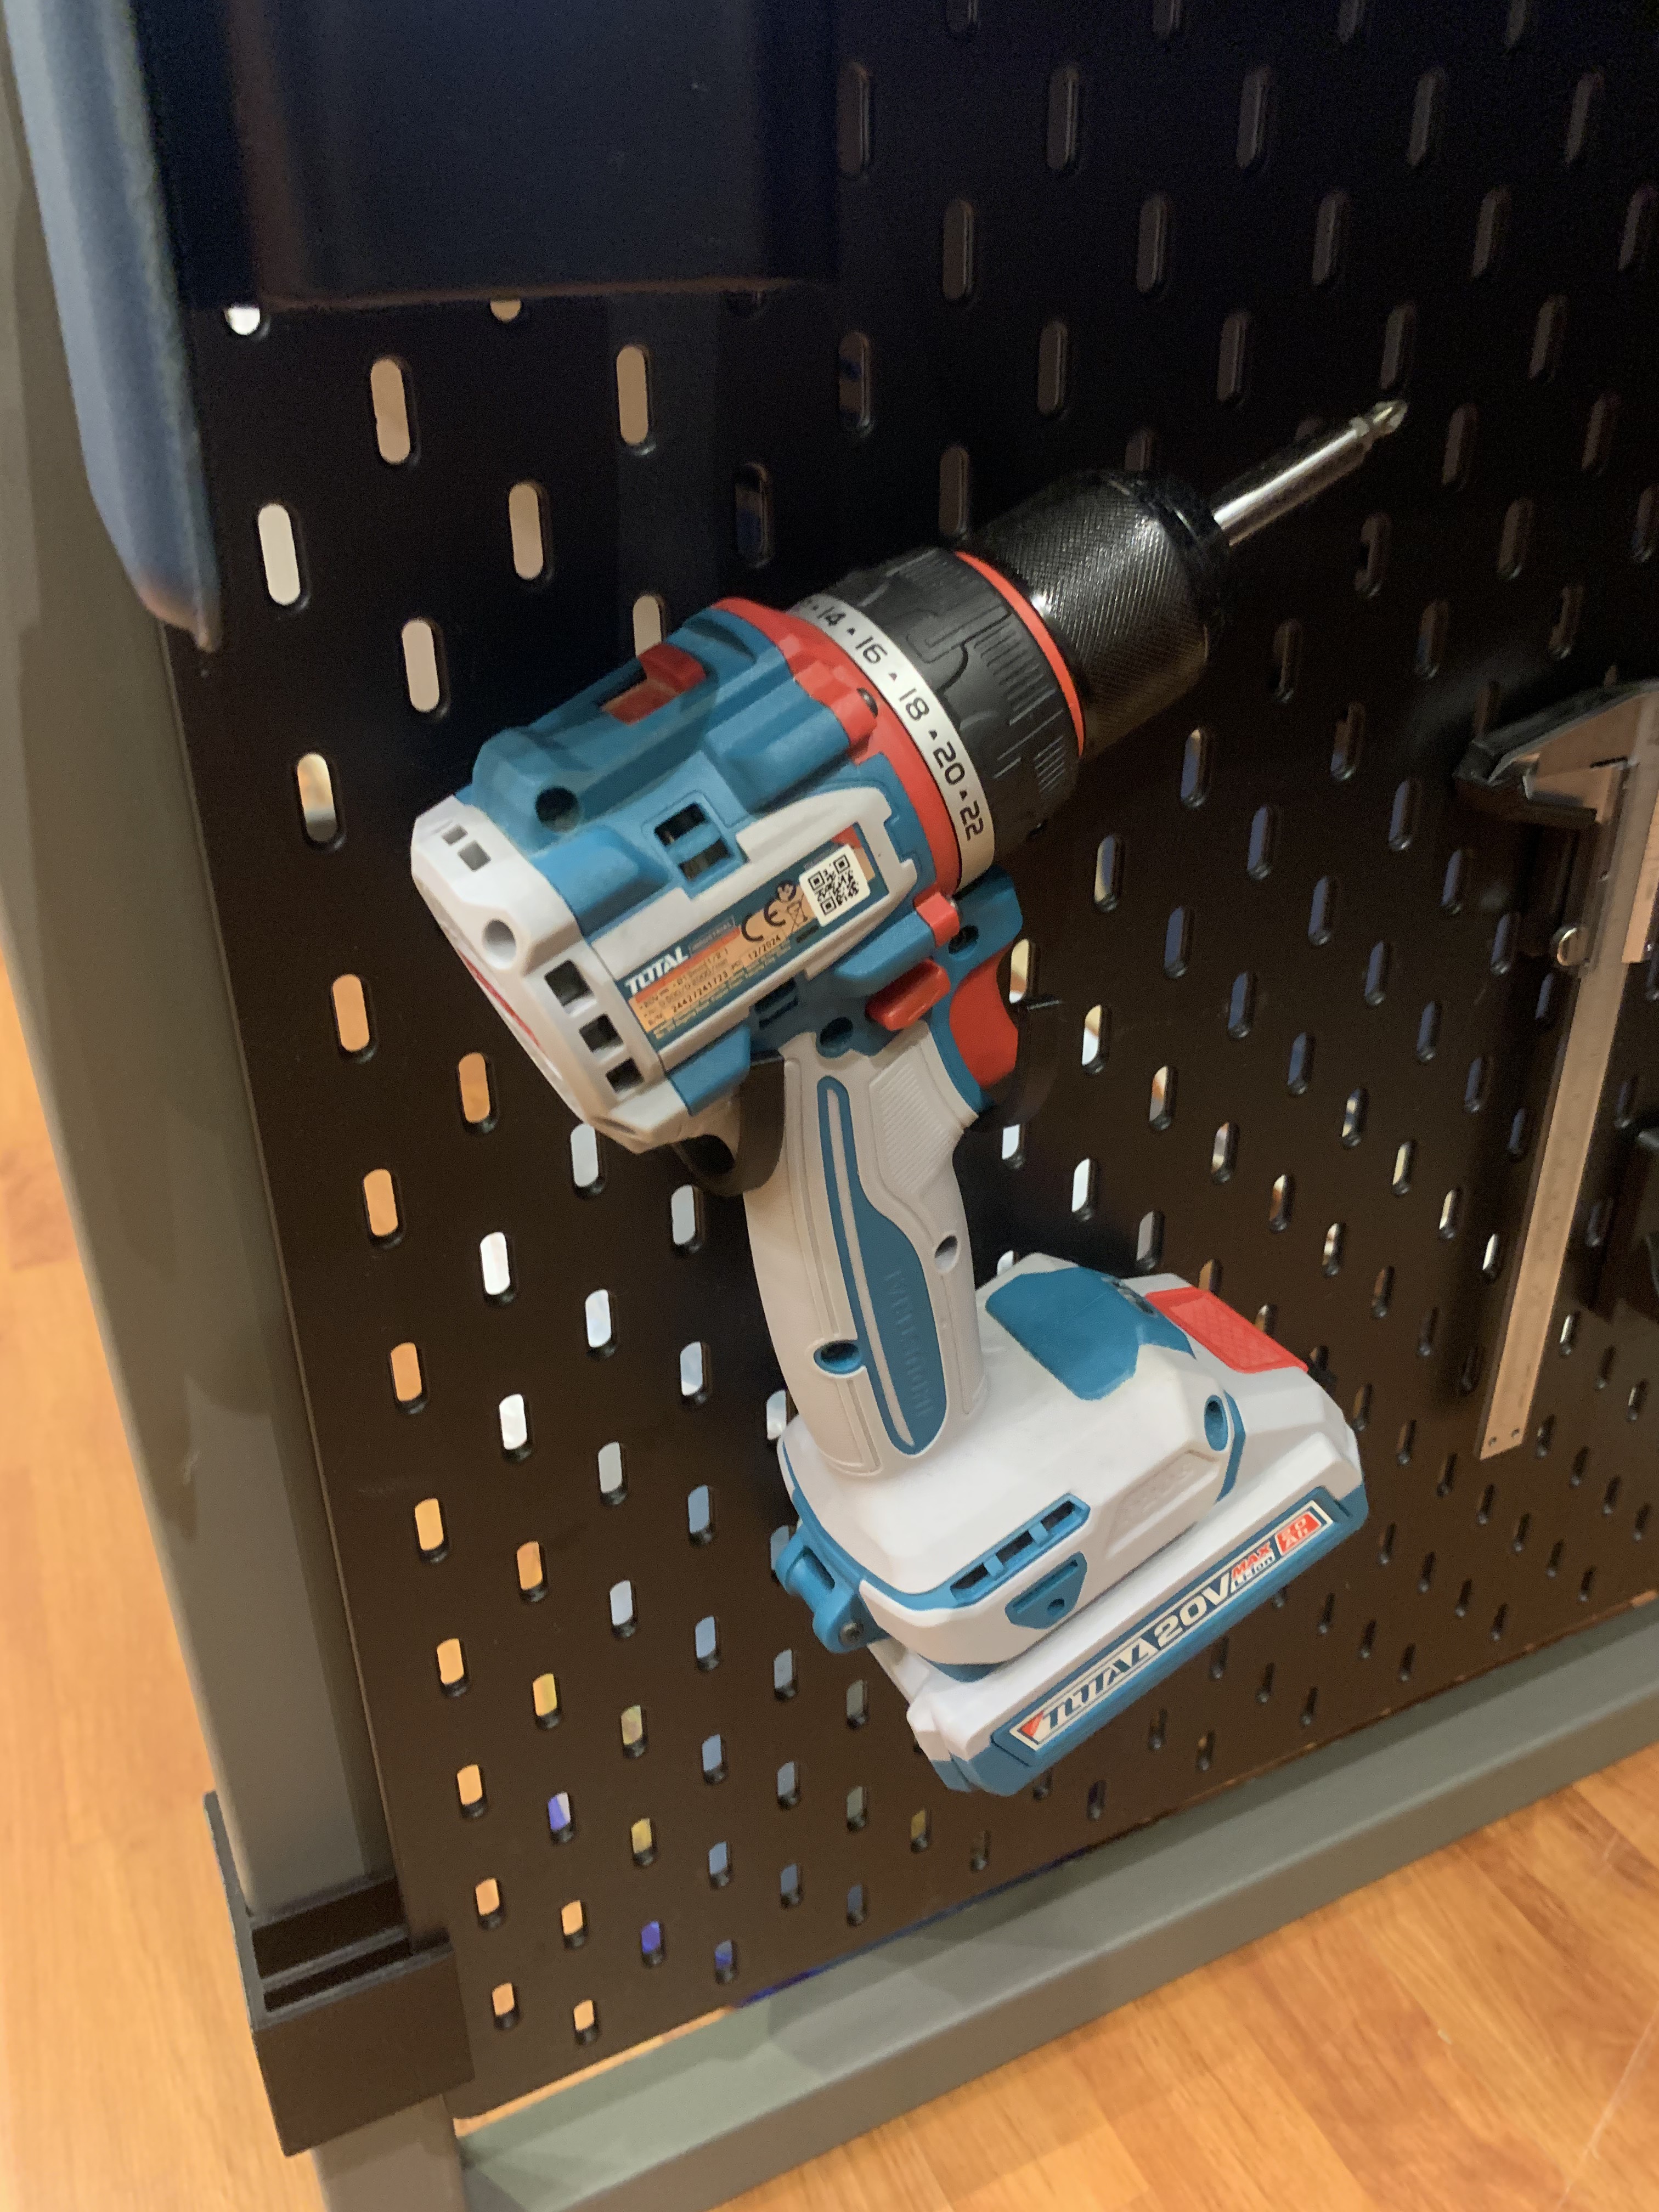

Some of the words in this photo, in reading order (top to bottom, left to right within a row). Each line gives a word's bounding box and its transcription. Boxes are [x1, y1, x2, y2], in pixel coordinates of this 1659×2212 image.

[817, 606, 846, 626] 14
[855, 637, 888, 664] 16
[899, 688, 930, 721] 18
[933, 741, 965, 785] 20
[960, 800, 984, 842] 22
[624, 946, 689, 996] TOTAL
[1043, 1643, 1149, 1729] TOTAL
[1154, 1572, 1231, 1647] 20V
[1232, 1541, 1271, 1579] MAX
